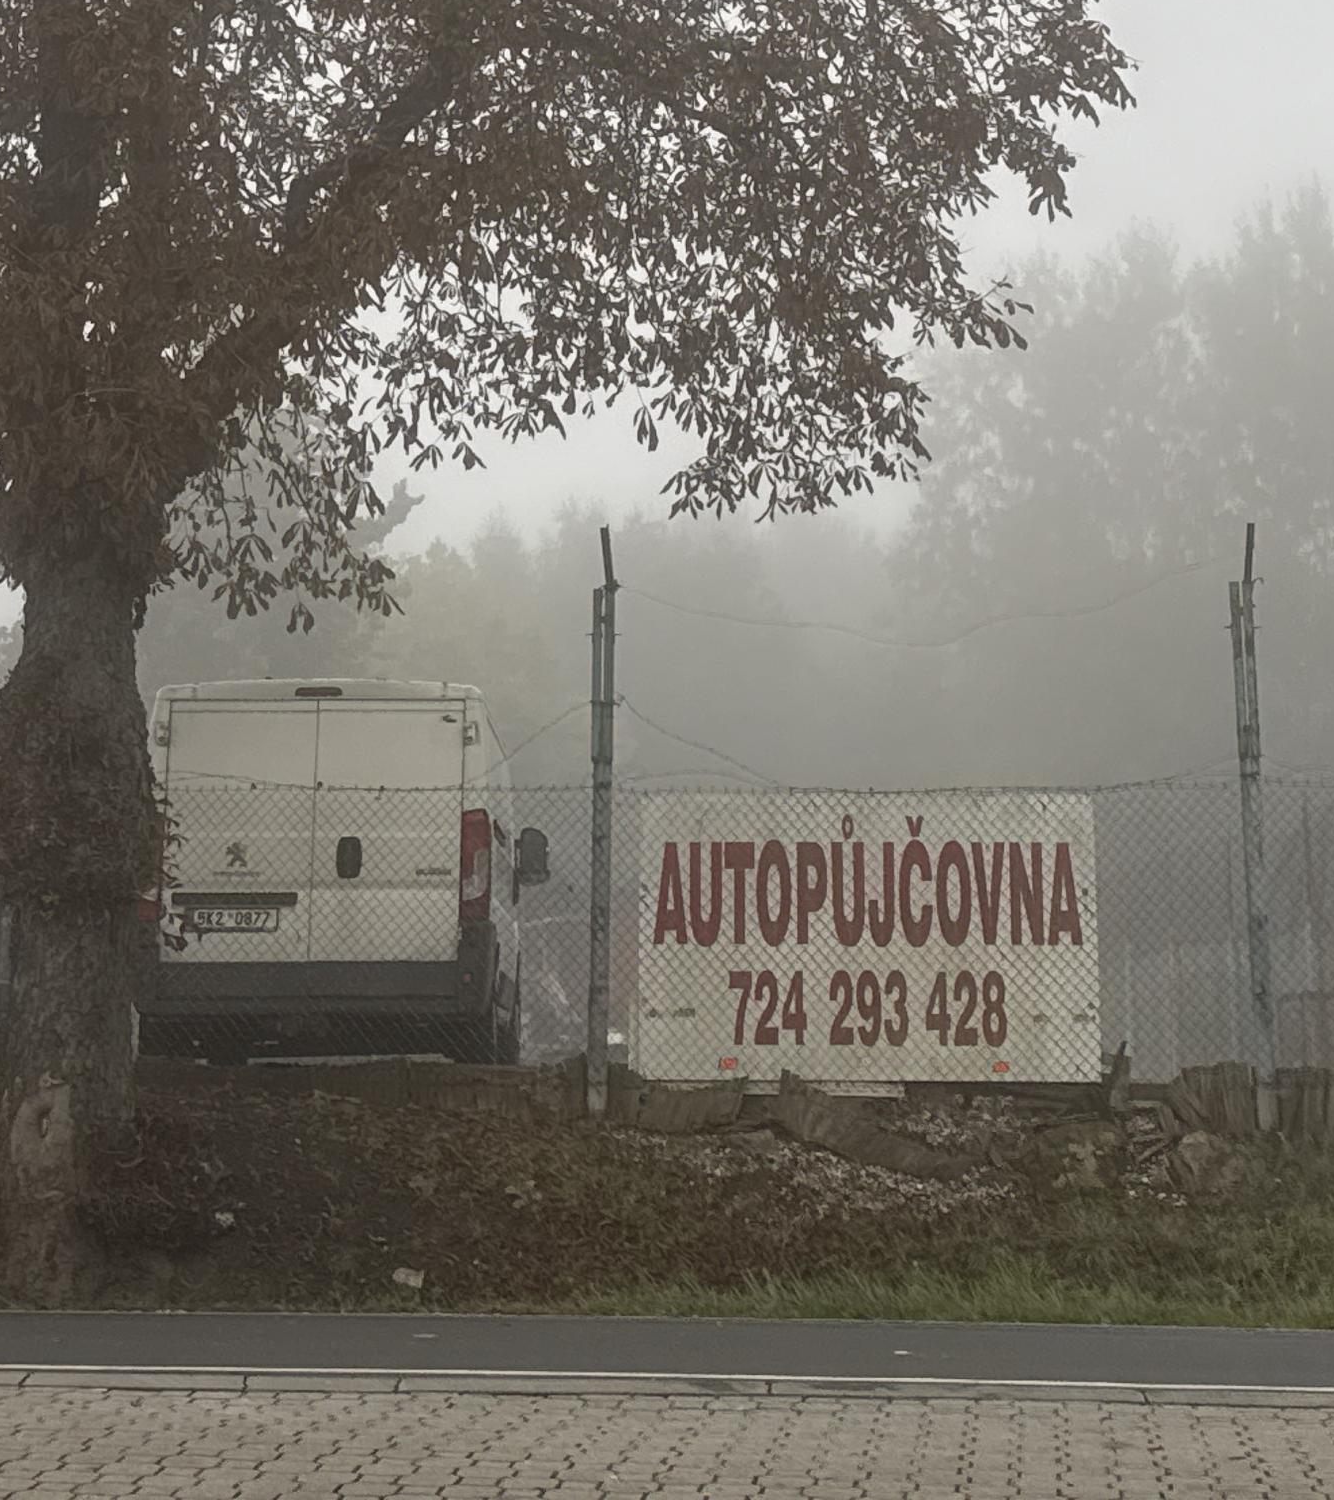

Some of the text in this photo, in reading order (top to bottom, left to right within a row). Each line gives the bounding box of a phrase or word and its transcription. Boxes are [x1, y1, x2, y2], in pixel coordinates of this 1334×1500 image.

[197, 911, 271, 926] 5K2 0877
[653, 814, 1084, 947] AUTOPŮJČOVNA
[728, 970, 1008, 1047] 724 293 428
